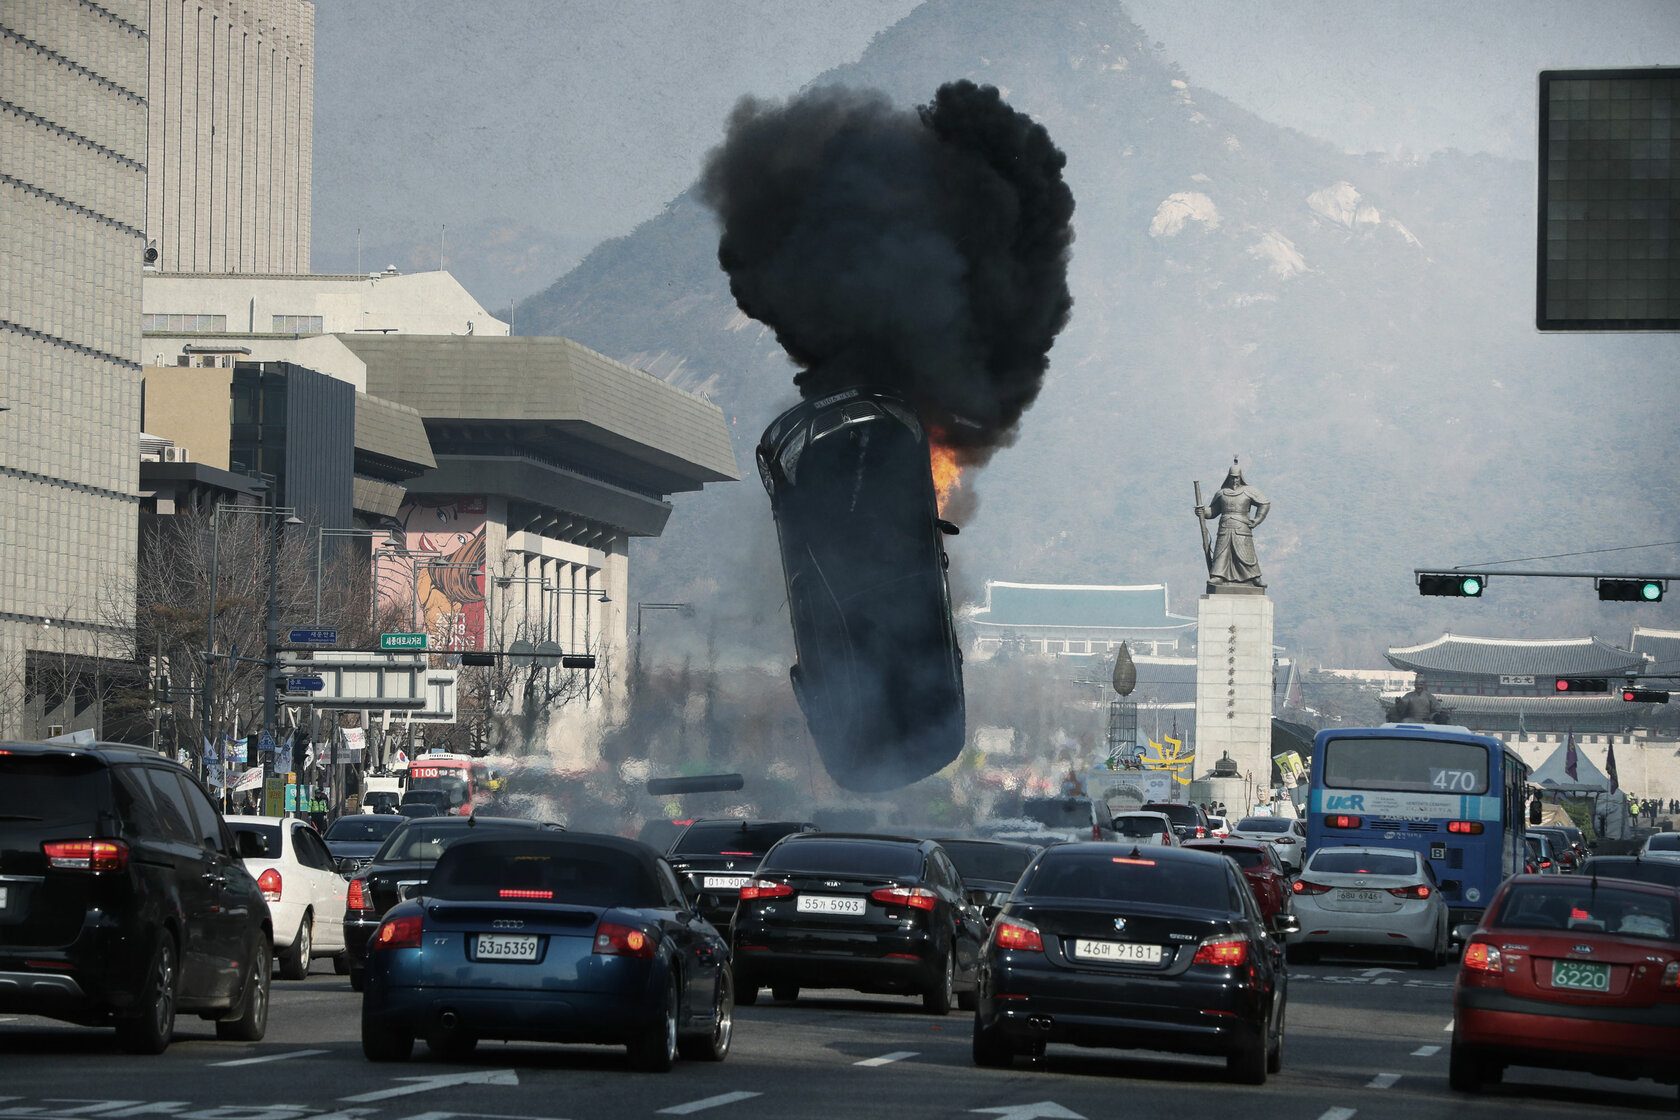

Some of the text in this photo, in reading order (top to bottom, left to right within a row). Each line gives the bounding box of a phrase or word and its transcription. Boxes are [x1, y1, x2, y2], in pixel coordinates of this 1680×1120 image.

[386, 636, 422, 646] 세종대로사거리
[414, 768, 438, 777] 1100
[1433, 771, 1475, 791] 470
[1434, 849, 1443, 858] B
[805, 898, 859, 912] 55가 5993
[434, 937, 449, 945] TT
[1083, 942, 1153, 960] 46머 9181
[1555, 969, 1606, 988] 6220
